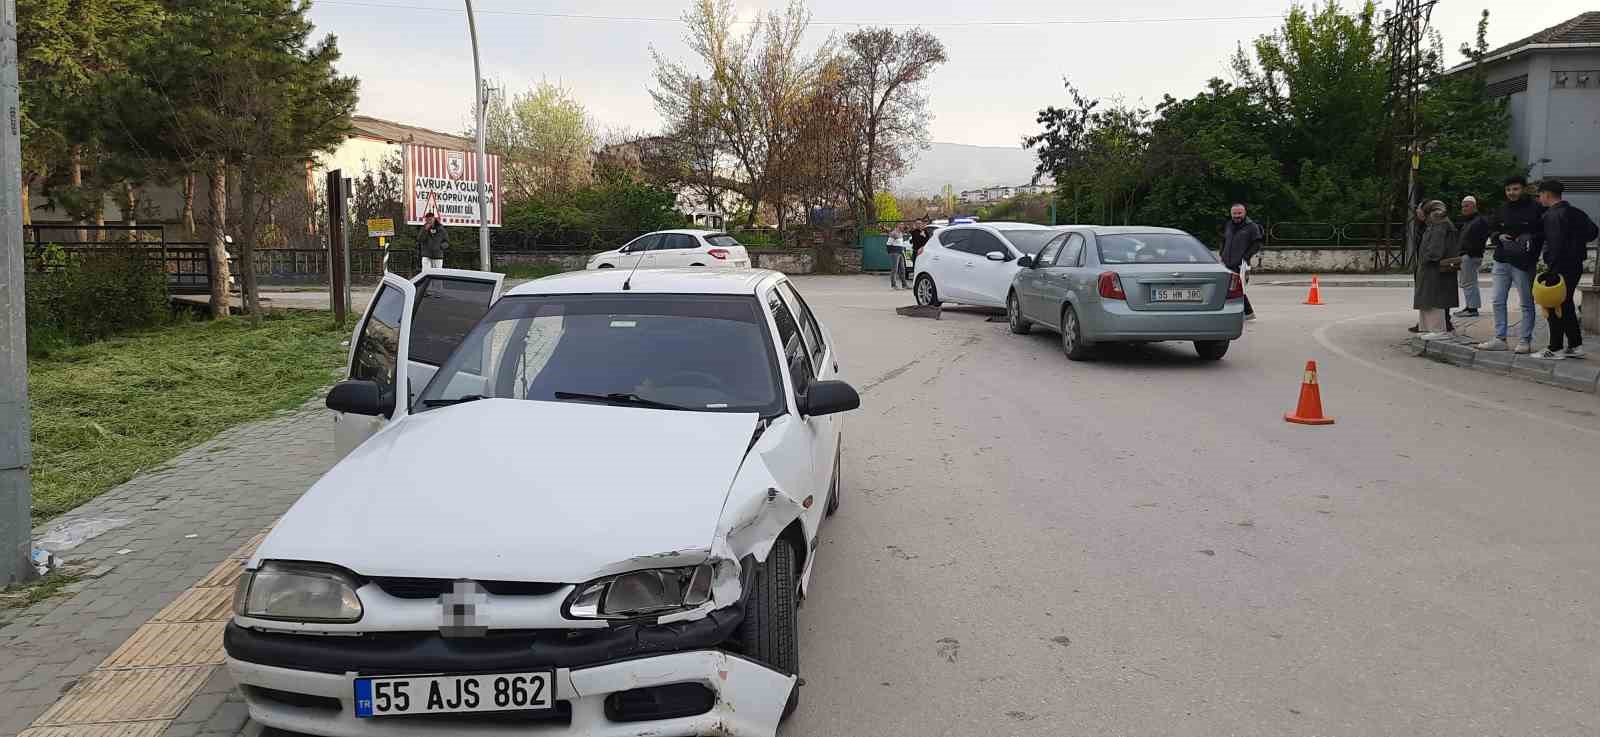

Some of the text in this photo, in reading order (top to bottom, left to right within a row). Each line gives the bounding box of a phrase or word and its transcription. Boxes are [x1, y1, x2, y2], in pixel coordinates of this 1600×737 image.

[416, 178, 453, 191] AVRUPA
[1158, 290, 1168, 300] 55
[359, 675, 545, 712] TR 55 AJS 862
